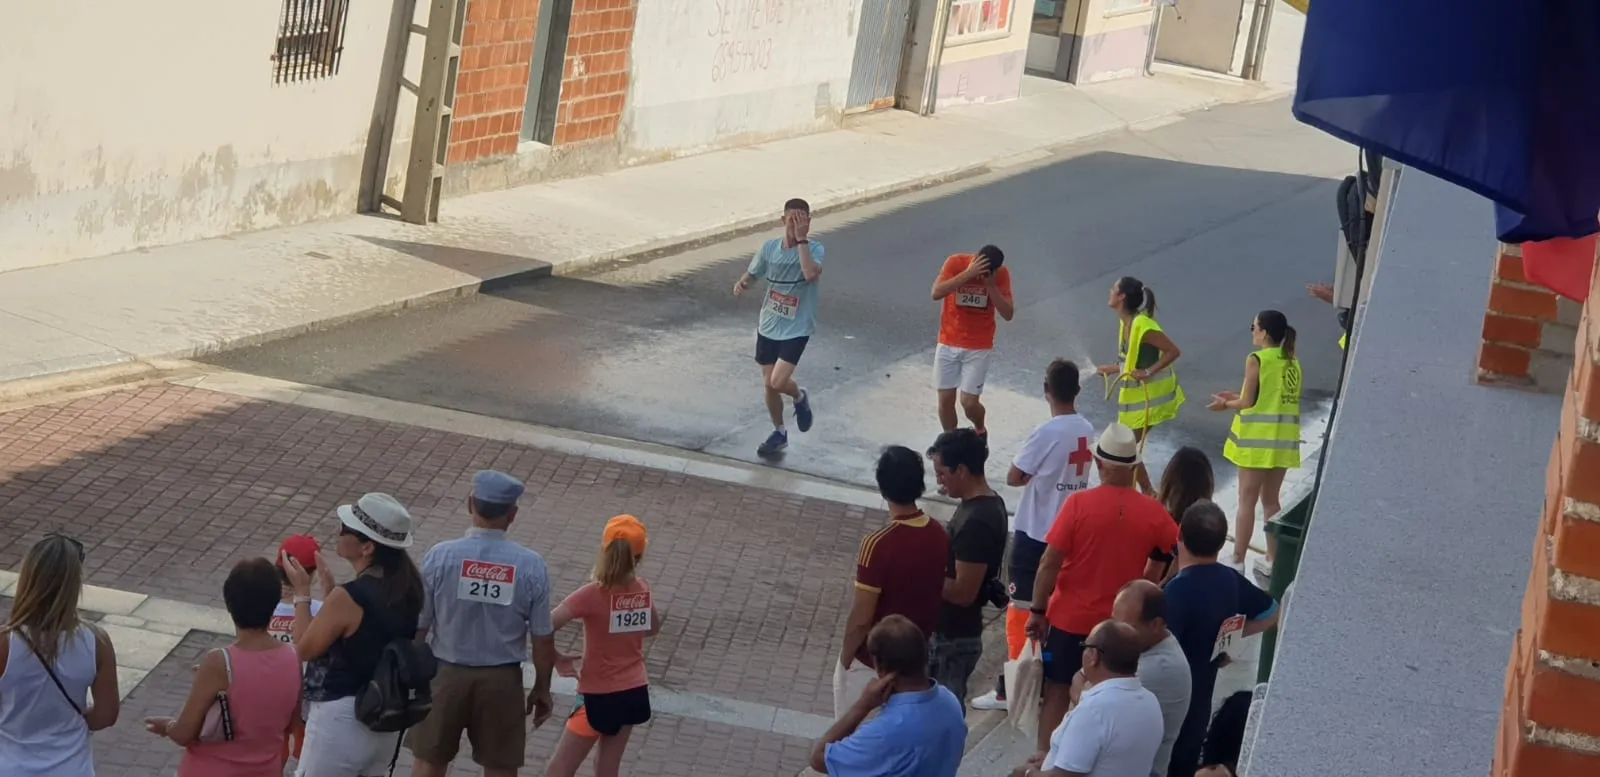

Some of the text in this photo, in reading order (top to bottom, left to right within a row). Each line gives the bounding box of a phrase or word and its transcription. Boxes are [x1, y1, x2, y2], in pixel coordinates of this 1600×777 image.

[962, 295, 981, 304] 246
[469, 582, 501, 599] 213
[616, 611, 647, 627] 1928
